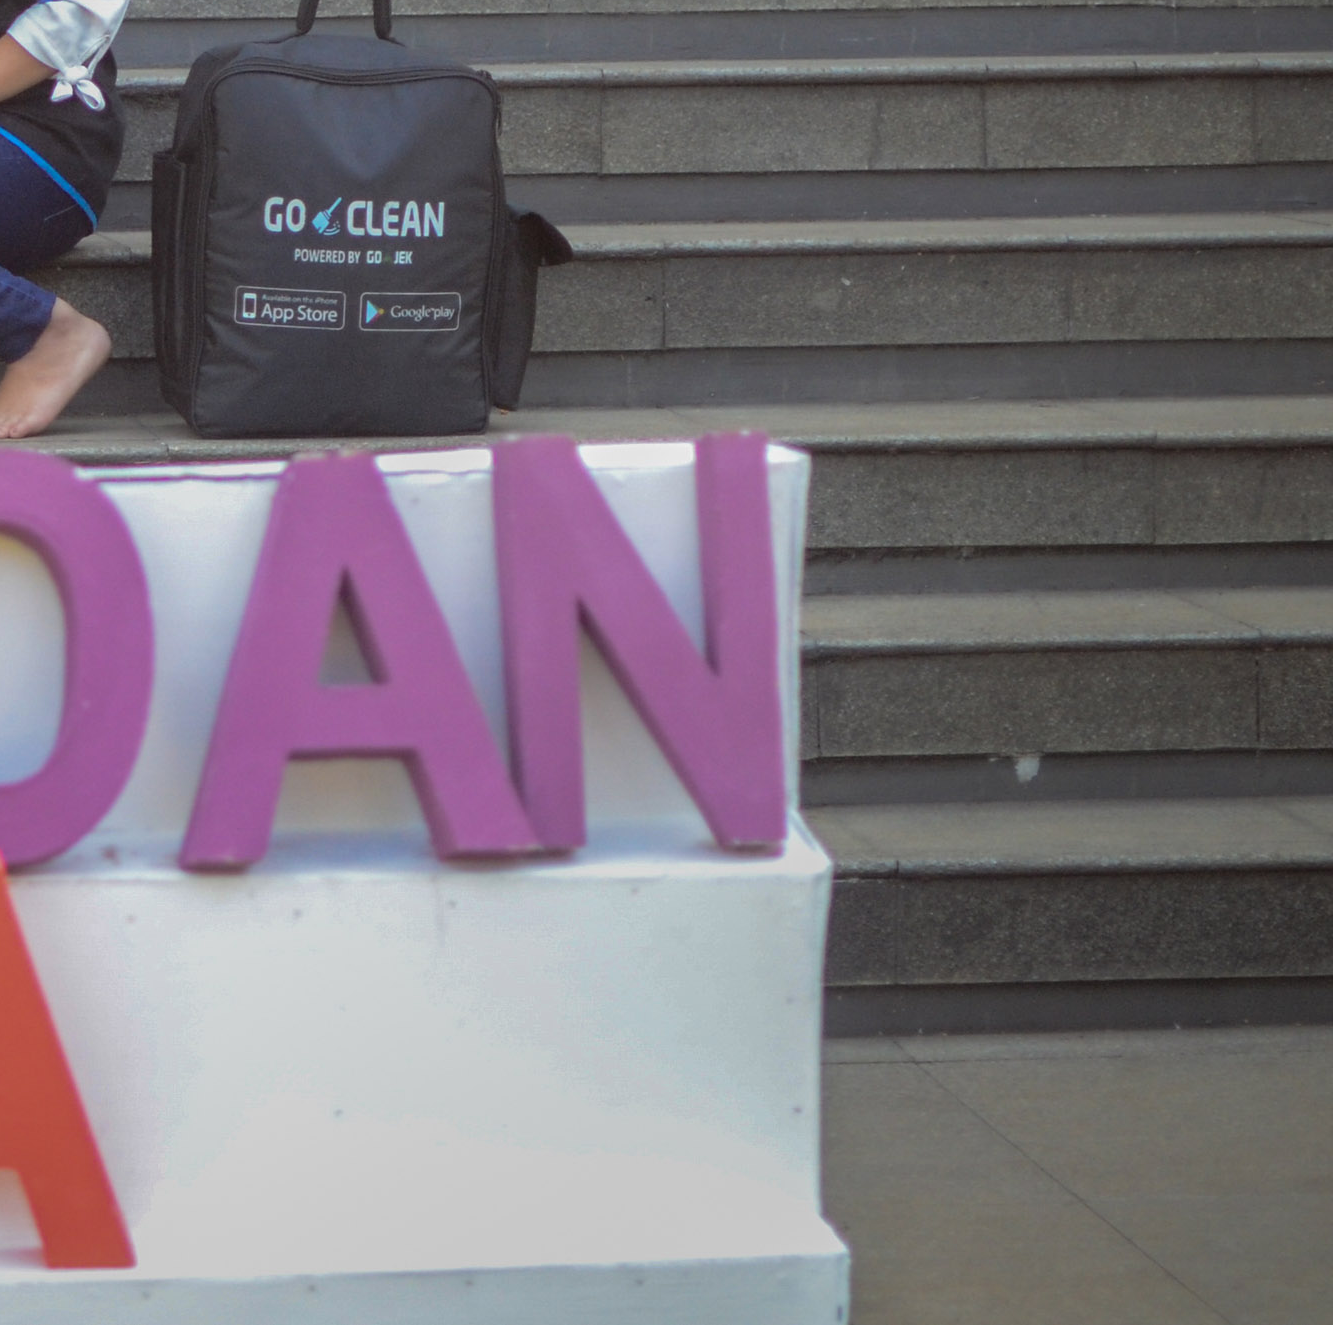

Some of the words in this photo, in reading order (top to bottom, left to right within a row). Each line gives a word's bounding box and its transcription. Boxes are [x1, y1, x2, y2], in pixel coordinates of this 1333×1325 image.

[263, 196, 307, 233] GO
[346, 200, 446, 238] CLEAN
[294, 248, 346, 264] POWERED
[348, 250, 362, 264] BY
[366, 250, 383, 264] GO
[393, 251, 414, 265] JEK
[261, 302, 295, 324] App
[297, 304, 338, 323] Store
[390, 304, 431, 322] Google
[433, 305, 456, 321] play
